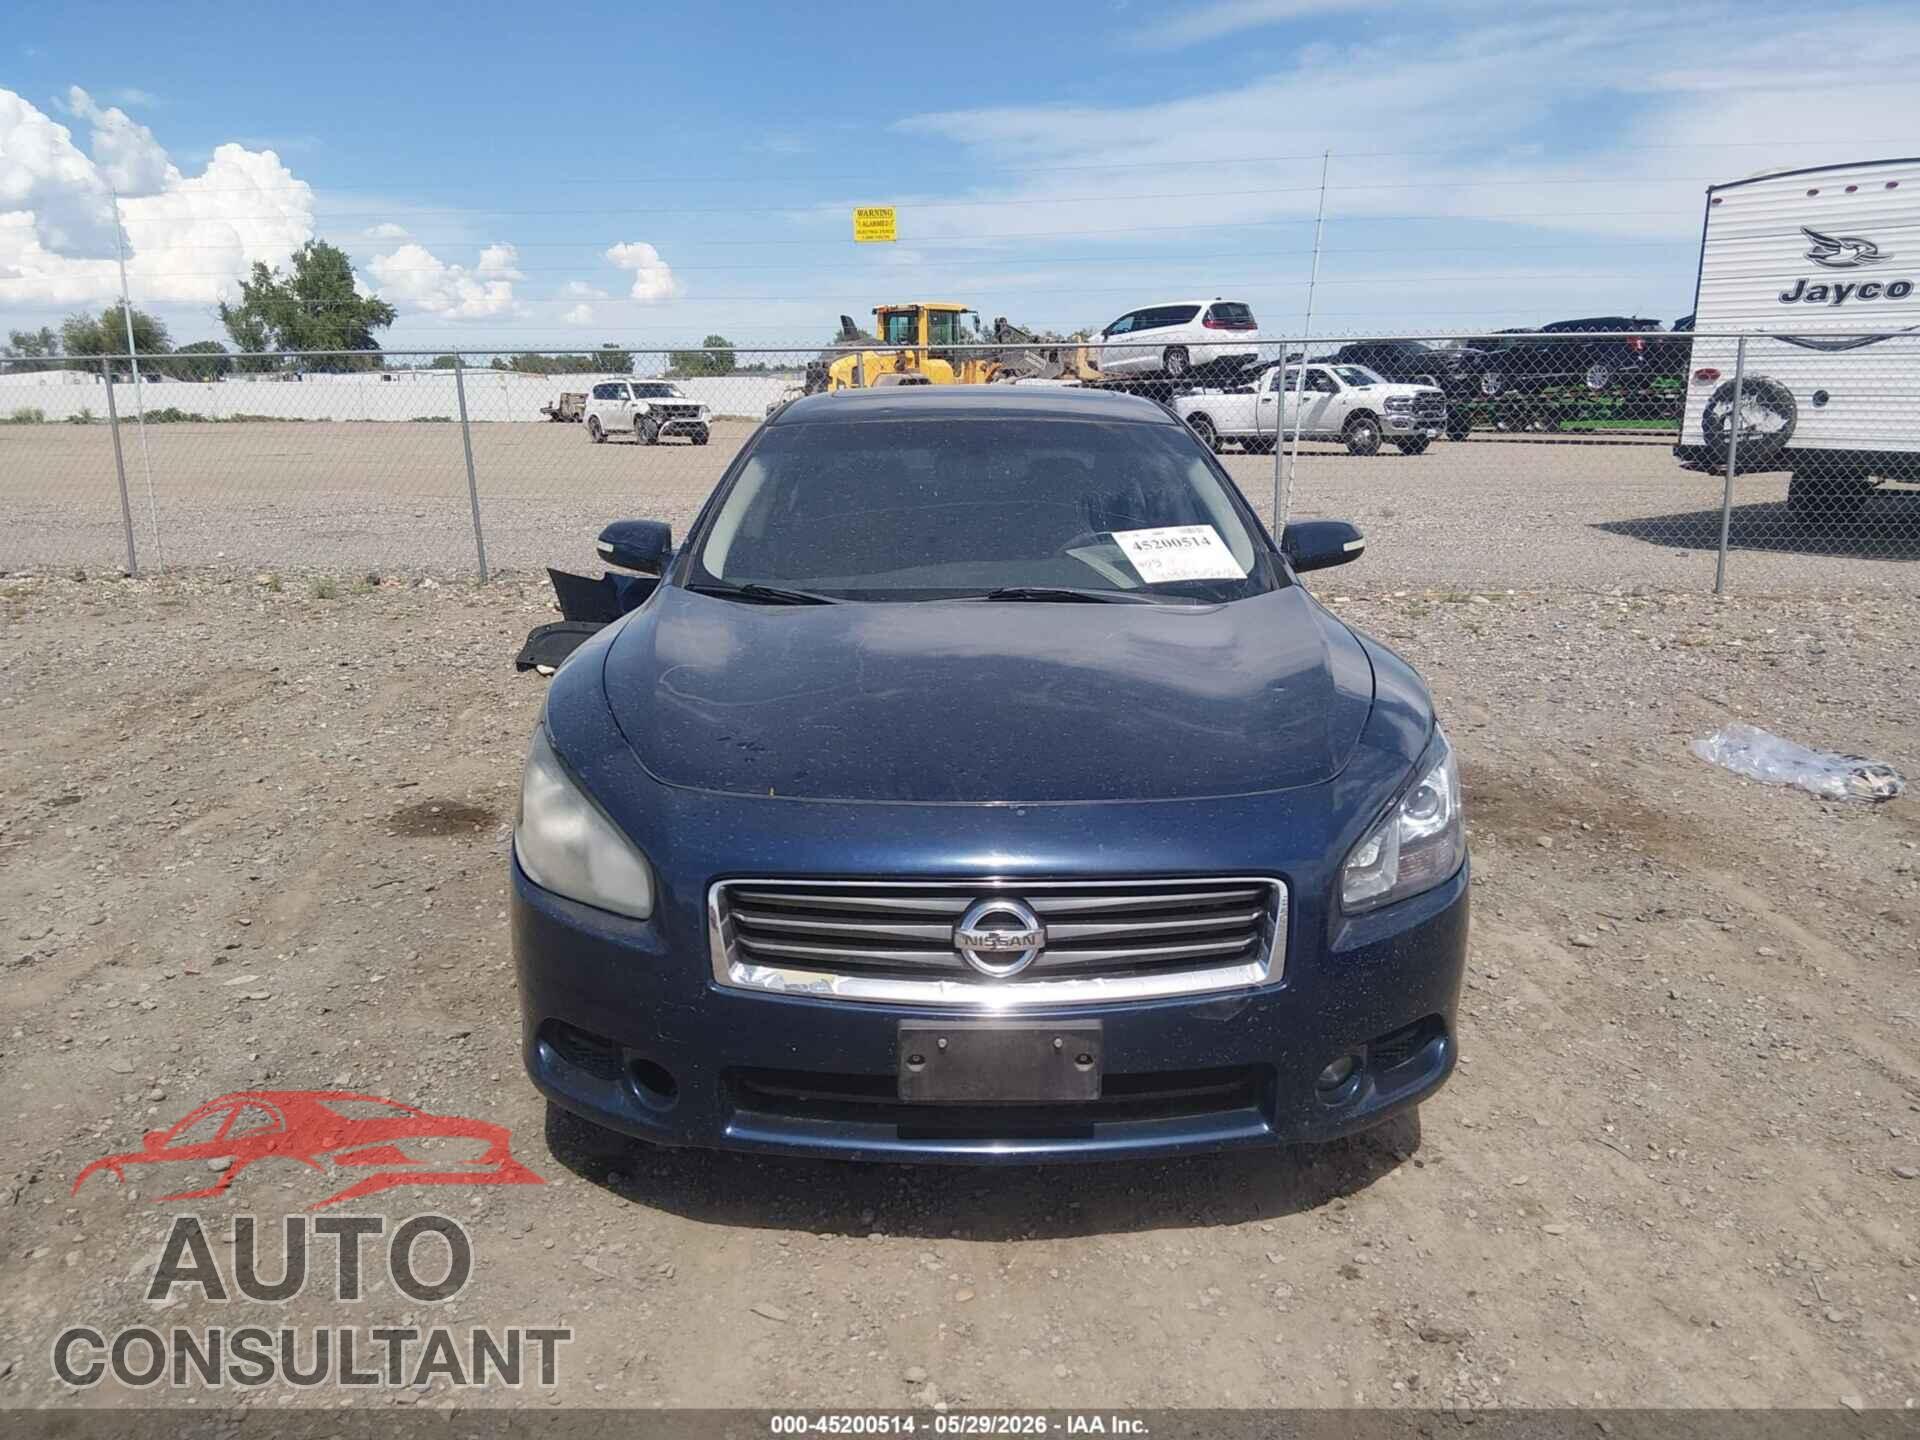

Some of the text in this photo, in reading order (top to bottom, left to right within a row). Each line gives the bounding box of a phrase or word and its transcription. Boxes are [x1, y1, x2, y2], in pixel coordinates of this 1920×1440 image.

[857, 209, 893, 217] WARNING
[1779, 278, 1913, 306] Jayco
[1132, 536, 1212, 551] 45200514
